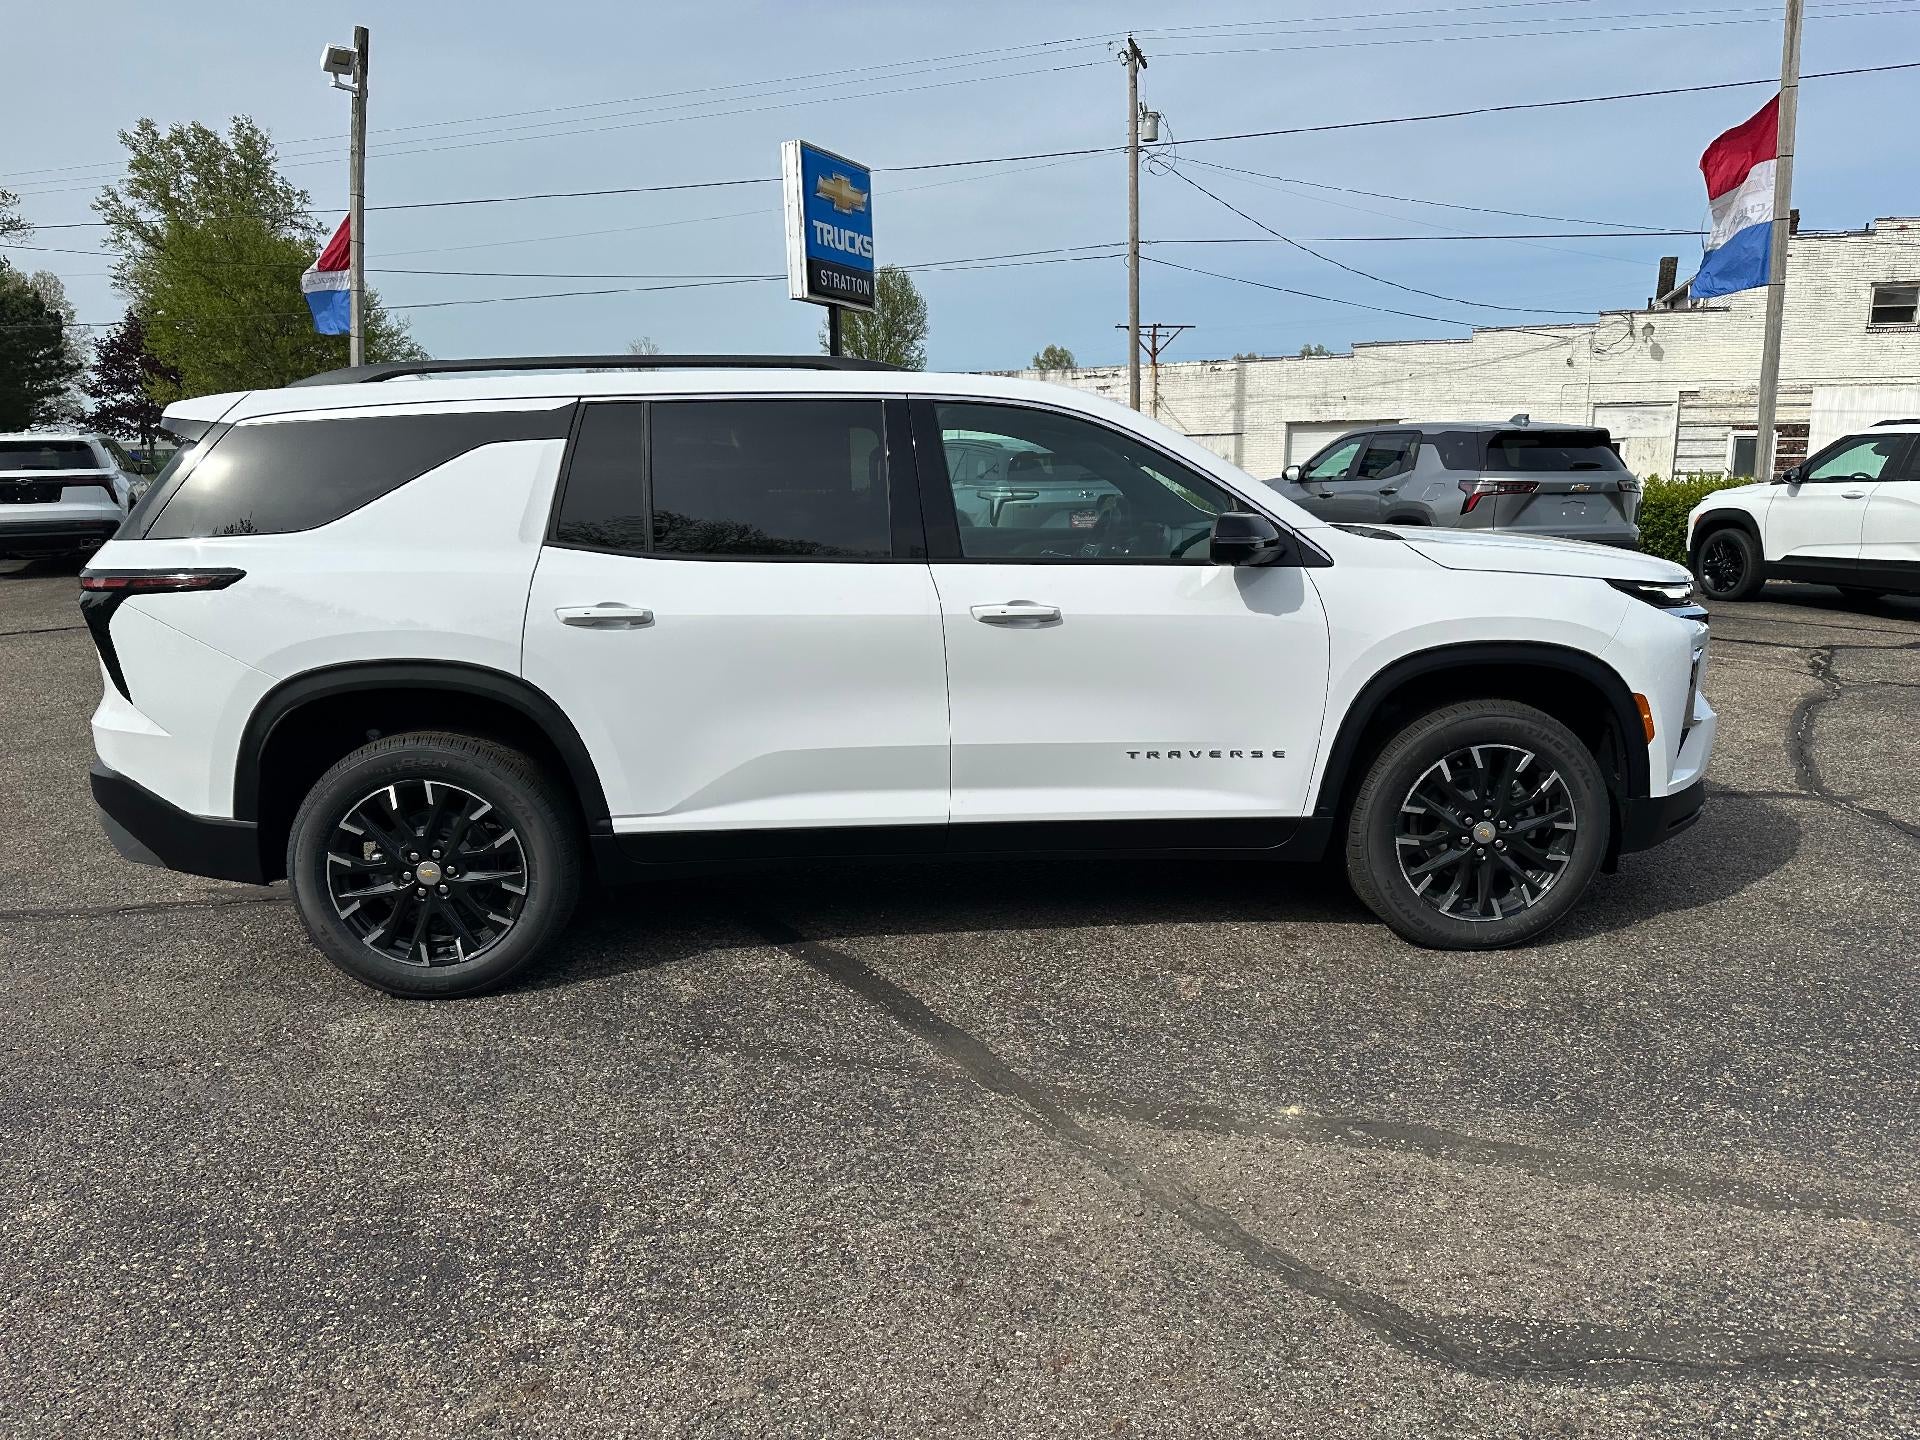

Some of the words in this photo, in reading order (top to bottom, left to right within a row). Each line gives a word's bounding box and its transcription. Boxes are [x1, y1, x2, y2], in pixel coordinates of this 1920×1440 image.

[812, 219, 873, 259] TRUCKS
[820, 269, 870, 296] STRATTON
[1126, 749, 1286, 760] TRAVERSE
